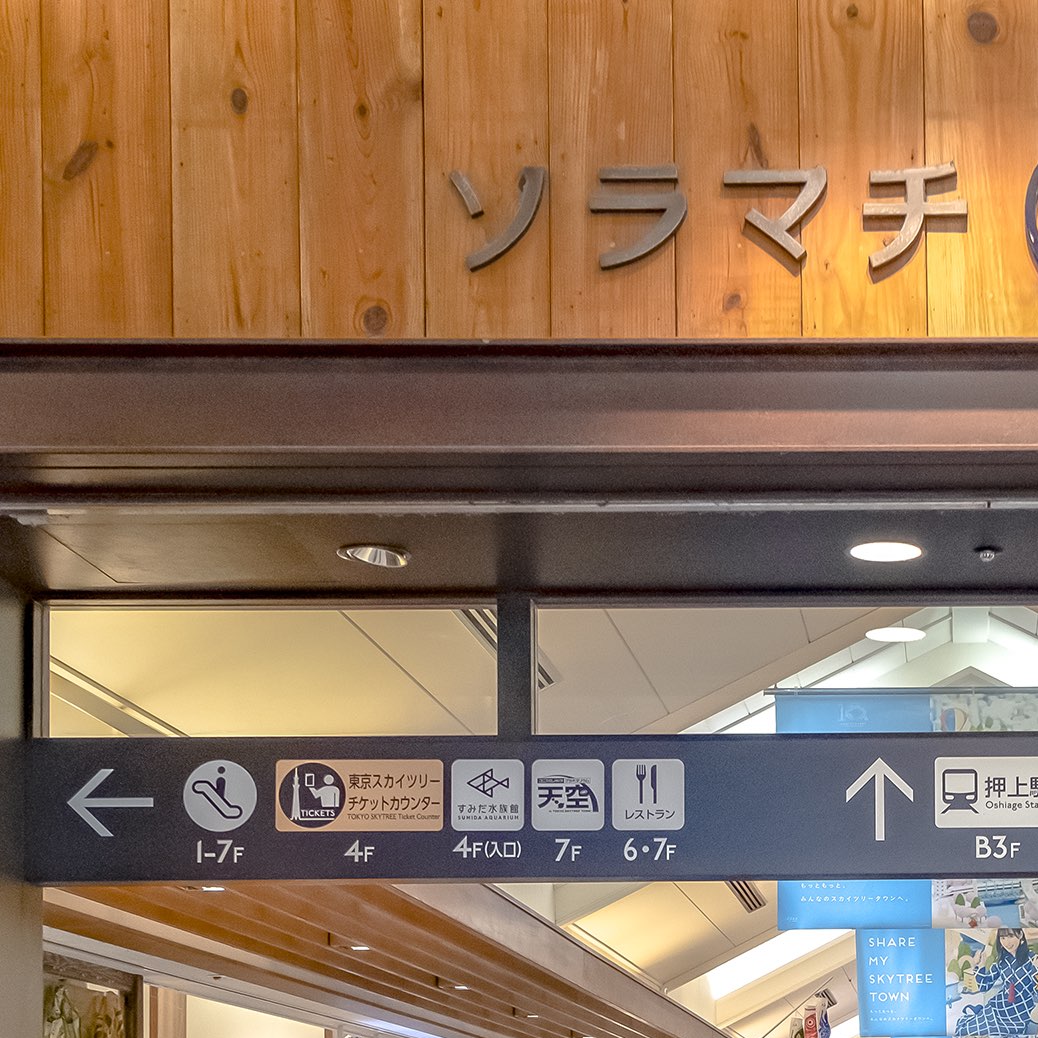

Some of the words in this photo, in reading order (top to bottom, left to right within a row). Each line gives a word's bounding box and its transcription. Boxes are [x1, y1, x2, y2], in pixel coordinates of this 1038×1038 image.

[349, 773, 441, 789] 東京スカイツリー
[348, 796, 441, 811] チケットカウンター
[537, 783, 599, 813] 天空
[457, 803, 519, 814] すみだ水族館
[985, 800, 1023, 811] Oshiage
[300, 809, 336, 817] TICKETS
[625, 809, 676, 820] レストラン
[196, 839, 245, 864] 1-7F
[344, 839, 375, 863] 4F
[555, 838, 582, 862] 7F
[976, 835, 1021, 859] B3F
[868, 937, 916, 947] SHARE
[868, 956, 889, 966] MY
[868, 973, 933, 984] SKYTREE
[869, 992, 910, 1002] TOWN
